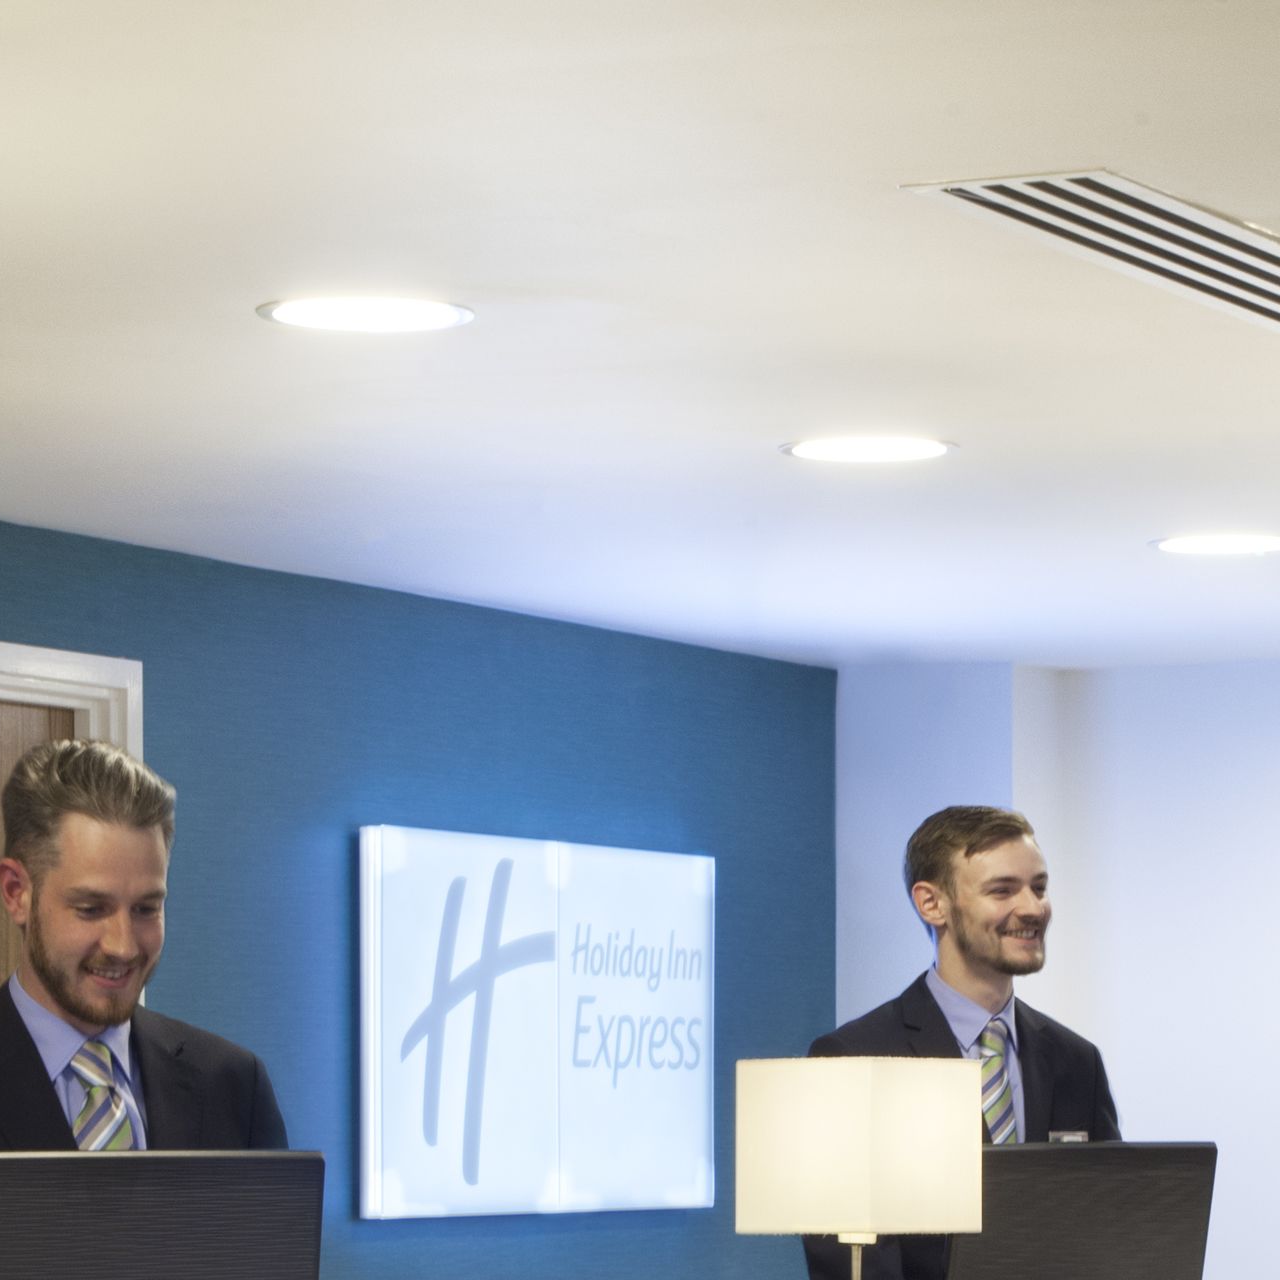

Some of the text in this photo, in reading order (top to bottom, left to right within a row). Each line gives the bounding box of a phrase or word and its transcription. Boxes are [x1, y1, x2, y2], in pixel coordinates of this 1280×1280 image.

[571, 922, 703, 992] Holiday Inn
[572, 995, 703, 1090] Express
